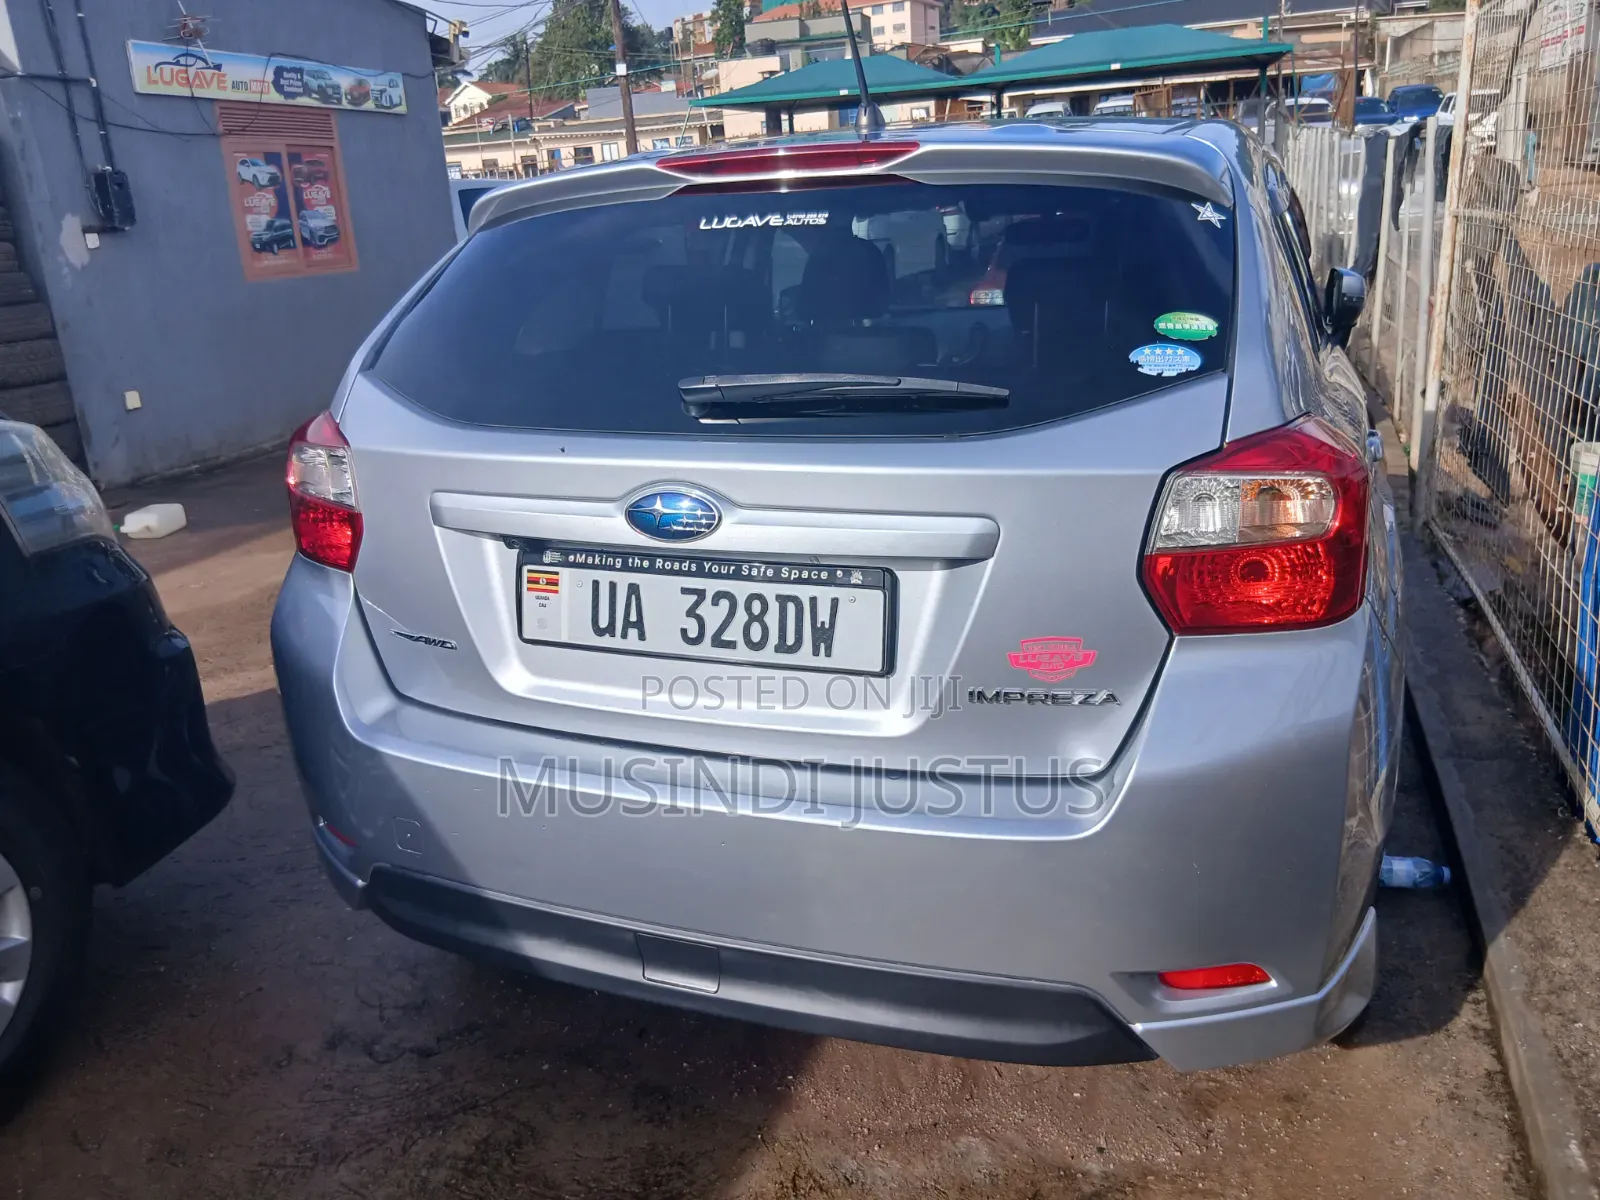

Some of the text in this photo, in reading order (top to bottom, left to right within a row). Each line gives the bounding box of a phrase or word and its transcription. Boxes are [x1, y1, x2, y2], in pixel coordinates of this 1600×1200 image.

[147, 65, 228, 91] LUGAVE
[231, 80, 249, 92] AUTO
[783, 217, 828, 227] AUTOS
[575, 553, 622, 569] Making
[628, 557, 650, 568] the
[655, 558, 697, 572] Roads
[703, 561, 736, 575] Your
[741, 564, 774, 577] Safe
[781, 567, 829, 580] Space
[590, 579, 839, 657] UA 328DW
[413, 635, 458, 650] AWD
[968, 686, 1122, 706] IMPREZA
